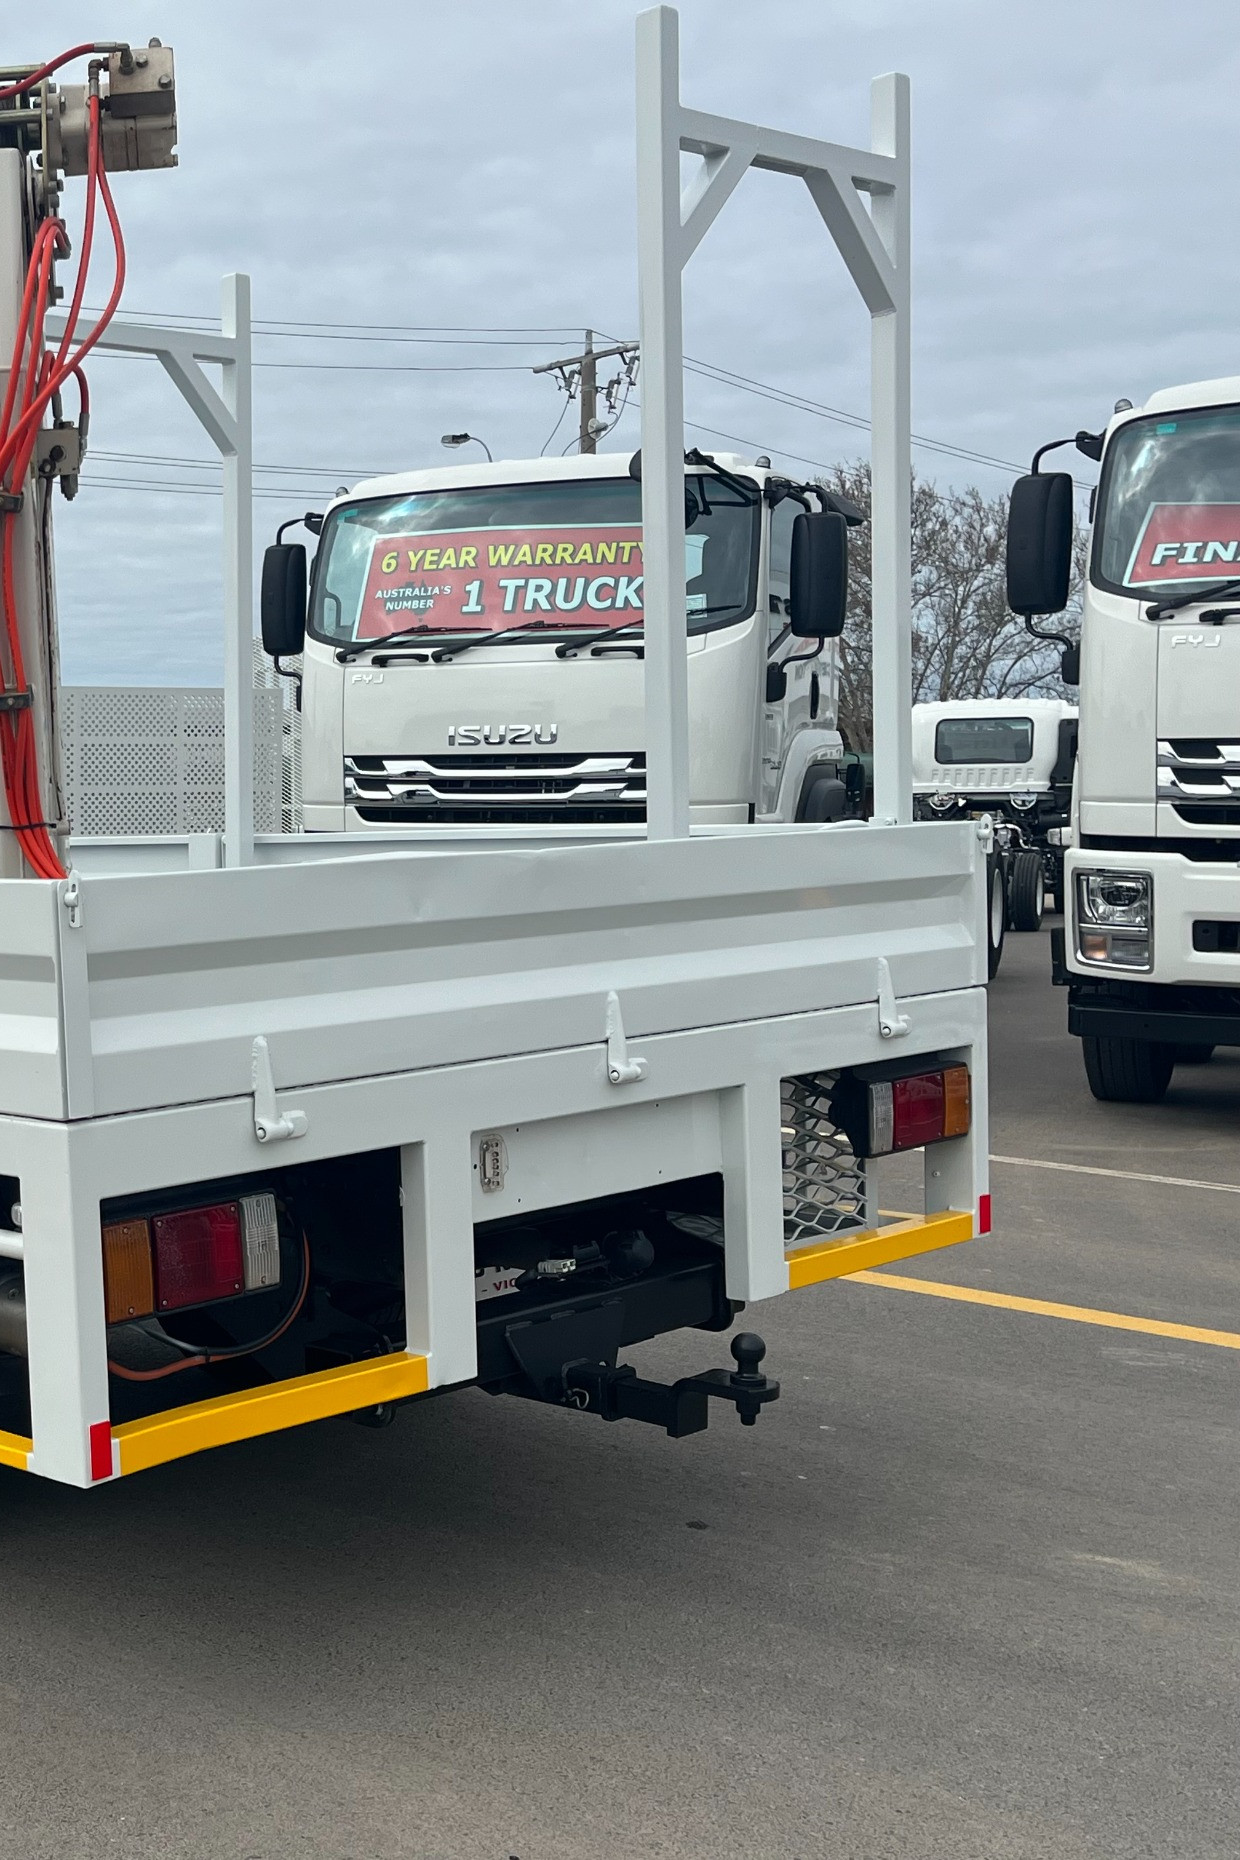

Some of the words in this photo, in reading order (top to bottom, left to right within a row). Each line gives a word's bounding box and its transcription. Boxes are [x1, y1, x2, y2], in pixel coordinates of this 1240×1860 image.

[381, 551, 398, 573] 6
[407, 546, 477, 571] YEAR
[1150, 540, 1240, 566] FIN
[374, 585, 452, 599] AUSTRALIA'S
[461, 579, 482, 613] 1
[498, 575, 645, 611] TRUCK
[385, 599, 434, 611] NUMBER
[1171, 634, 1222, 649] FYJ
[351, 673, 385, 685] FYJ
[447, 723, 558, 747] ISUZU
